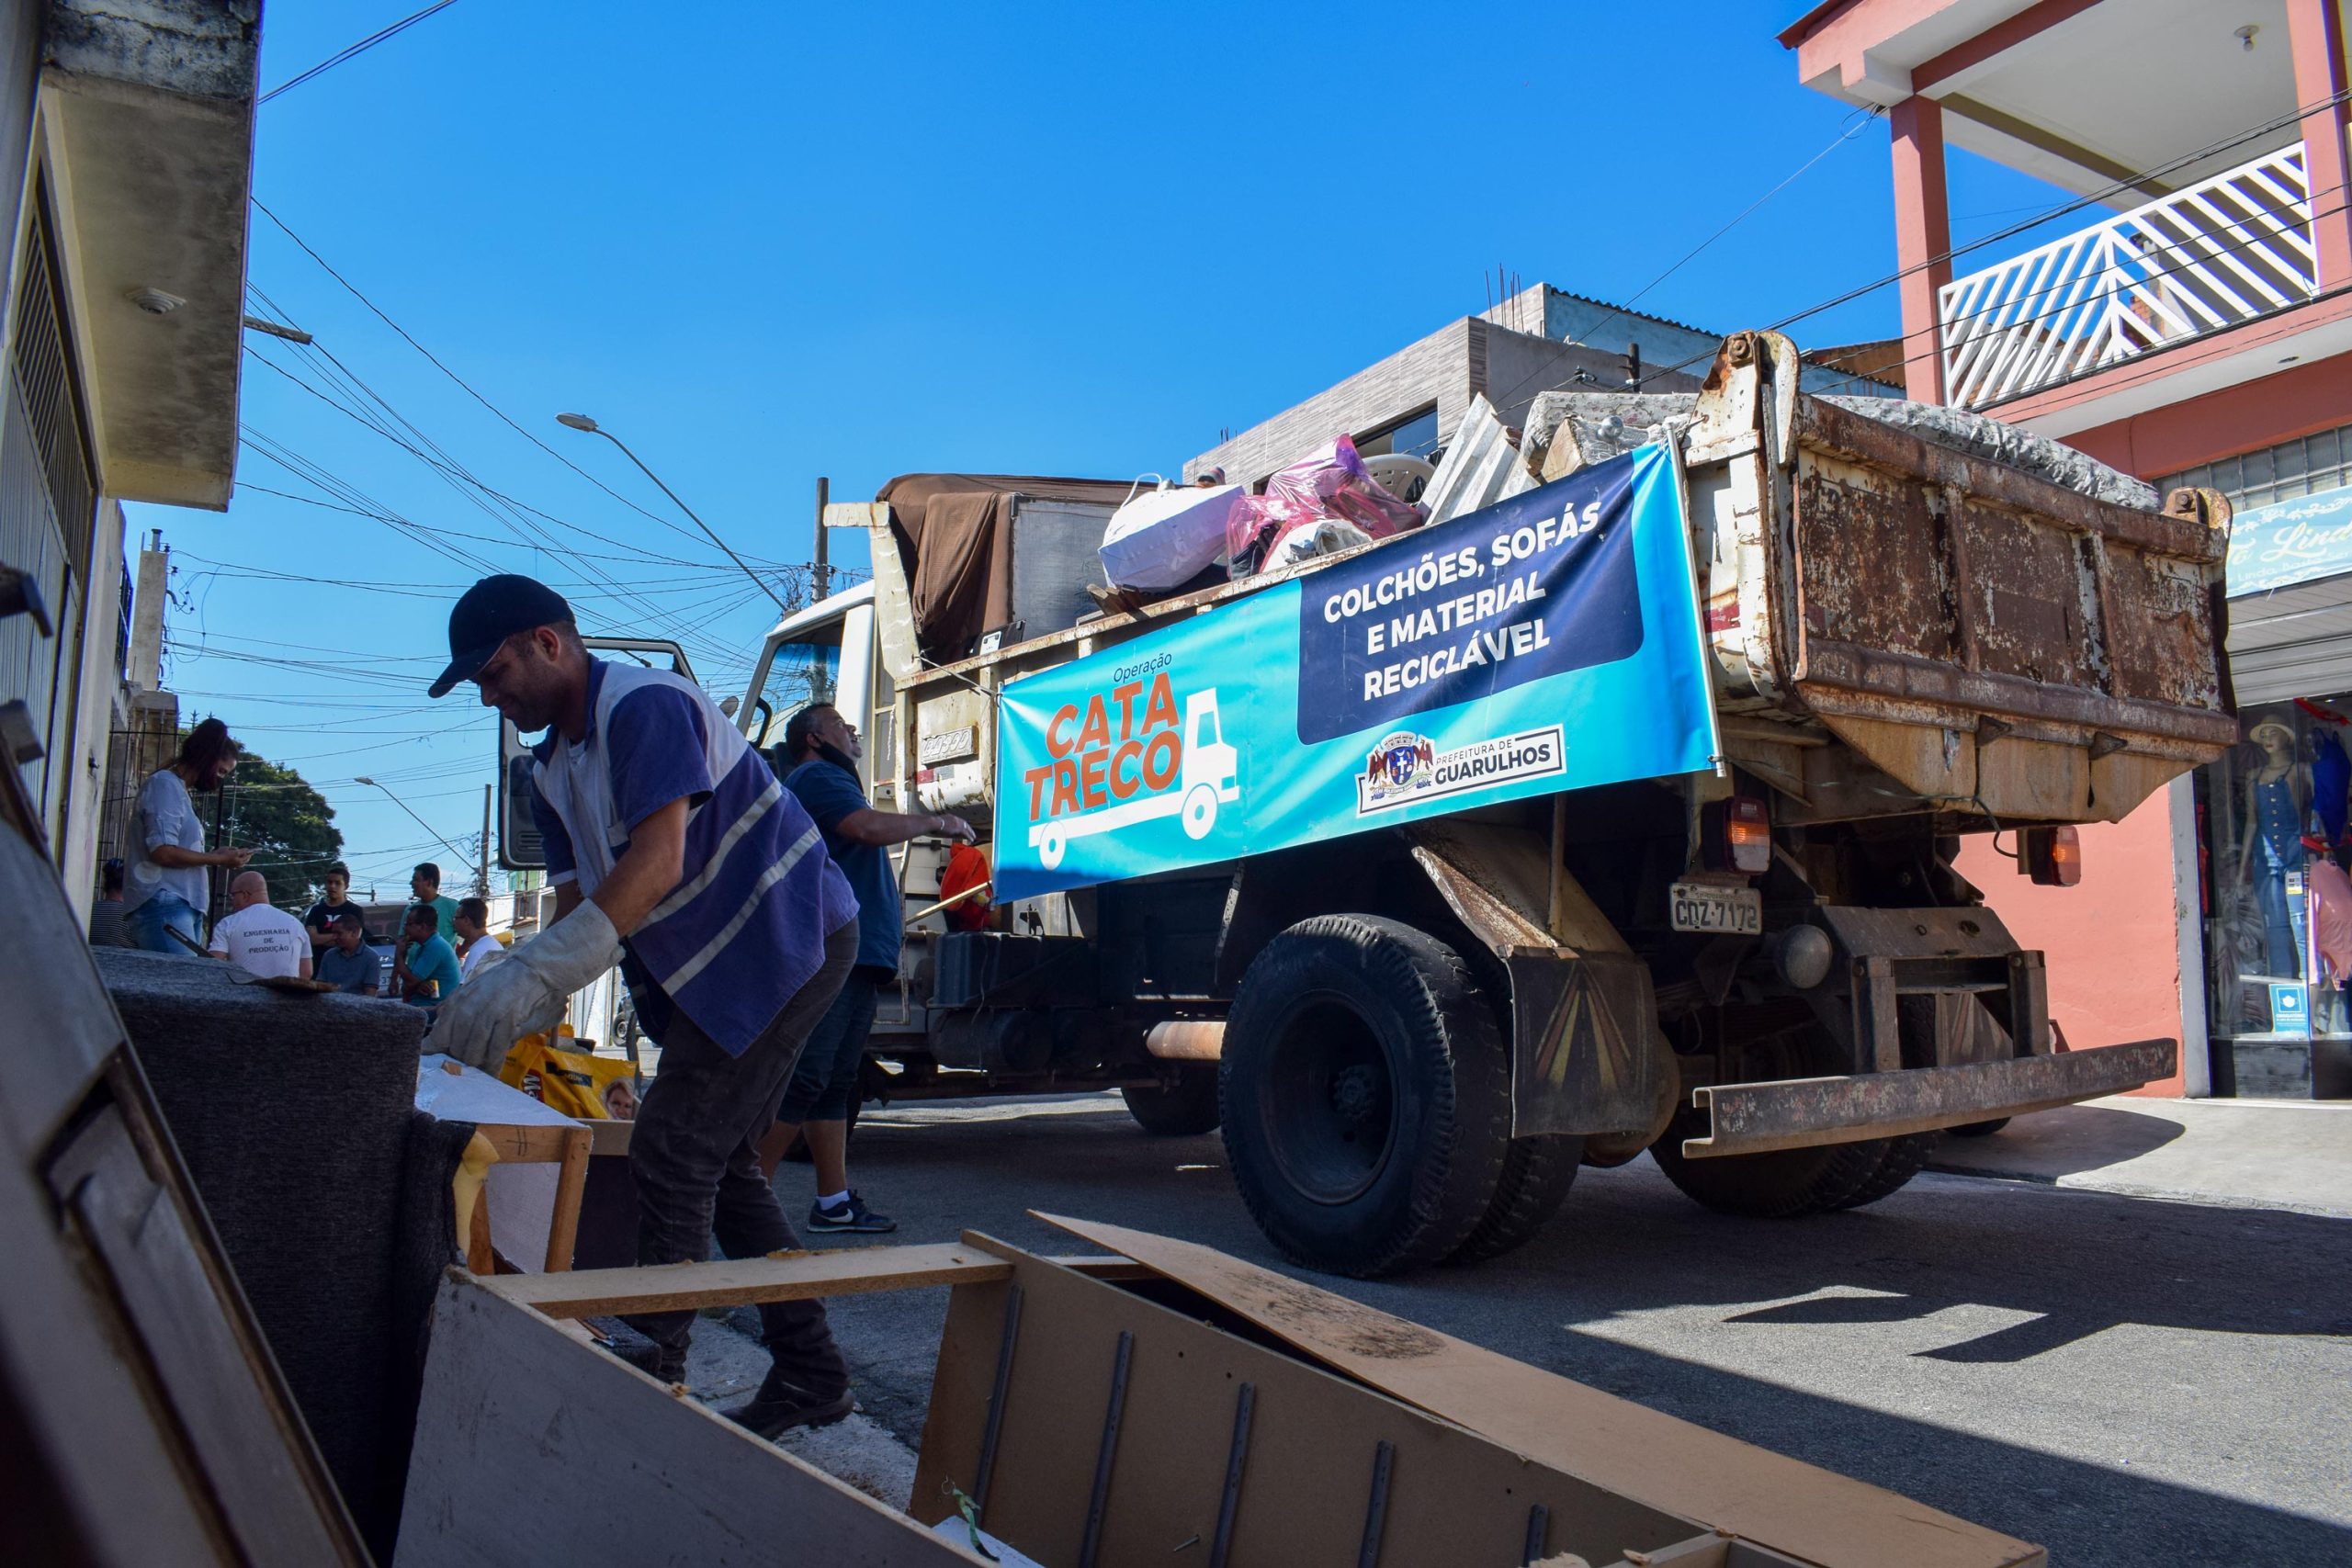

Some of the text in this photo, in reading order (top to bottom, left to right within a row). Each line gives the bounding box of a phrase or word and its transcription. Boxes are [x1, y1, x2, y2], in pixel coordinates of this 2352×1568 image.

[1324, 502, 1602, 624] COLCHÕES, SOFÁS
[1367, 570, 1546, 656] E MATERIAL
[1113, 651, 1172, 683] Operação
[1364, 618, 1551, 701] RECICLÁVEL
[1046, 671, 1180, 760] CATA
[1023, 729, 1182, 822] TRECO
[1434, 743, 1551, 785] GUARULHOS
[1436, 739, 1513, 765] PREFEITURA DE
[243, 929, 290, 937] ENGENHARIA
[249, 943, 289, 953] PRODUÇÃO
